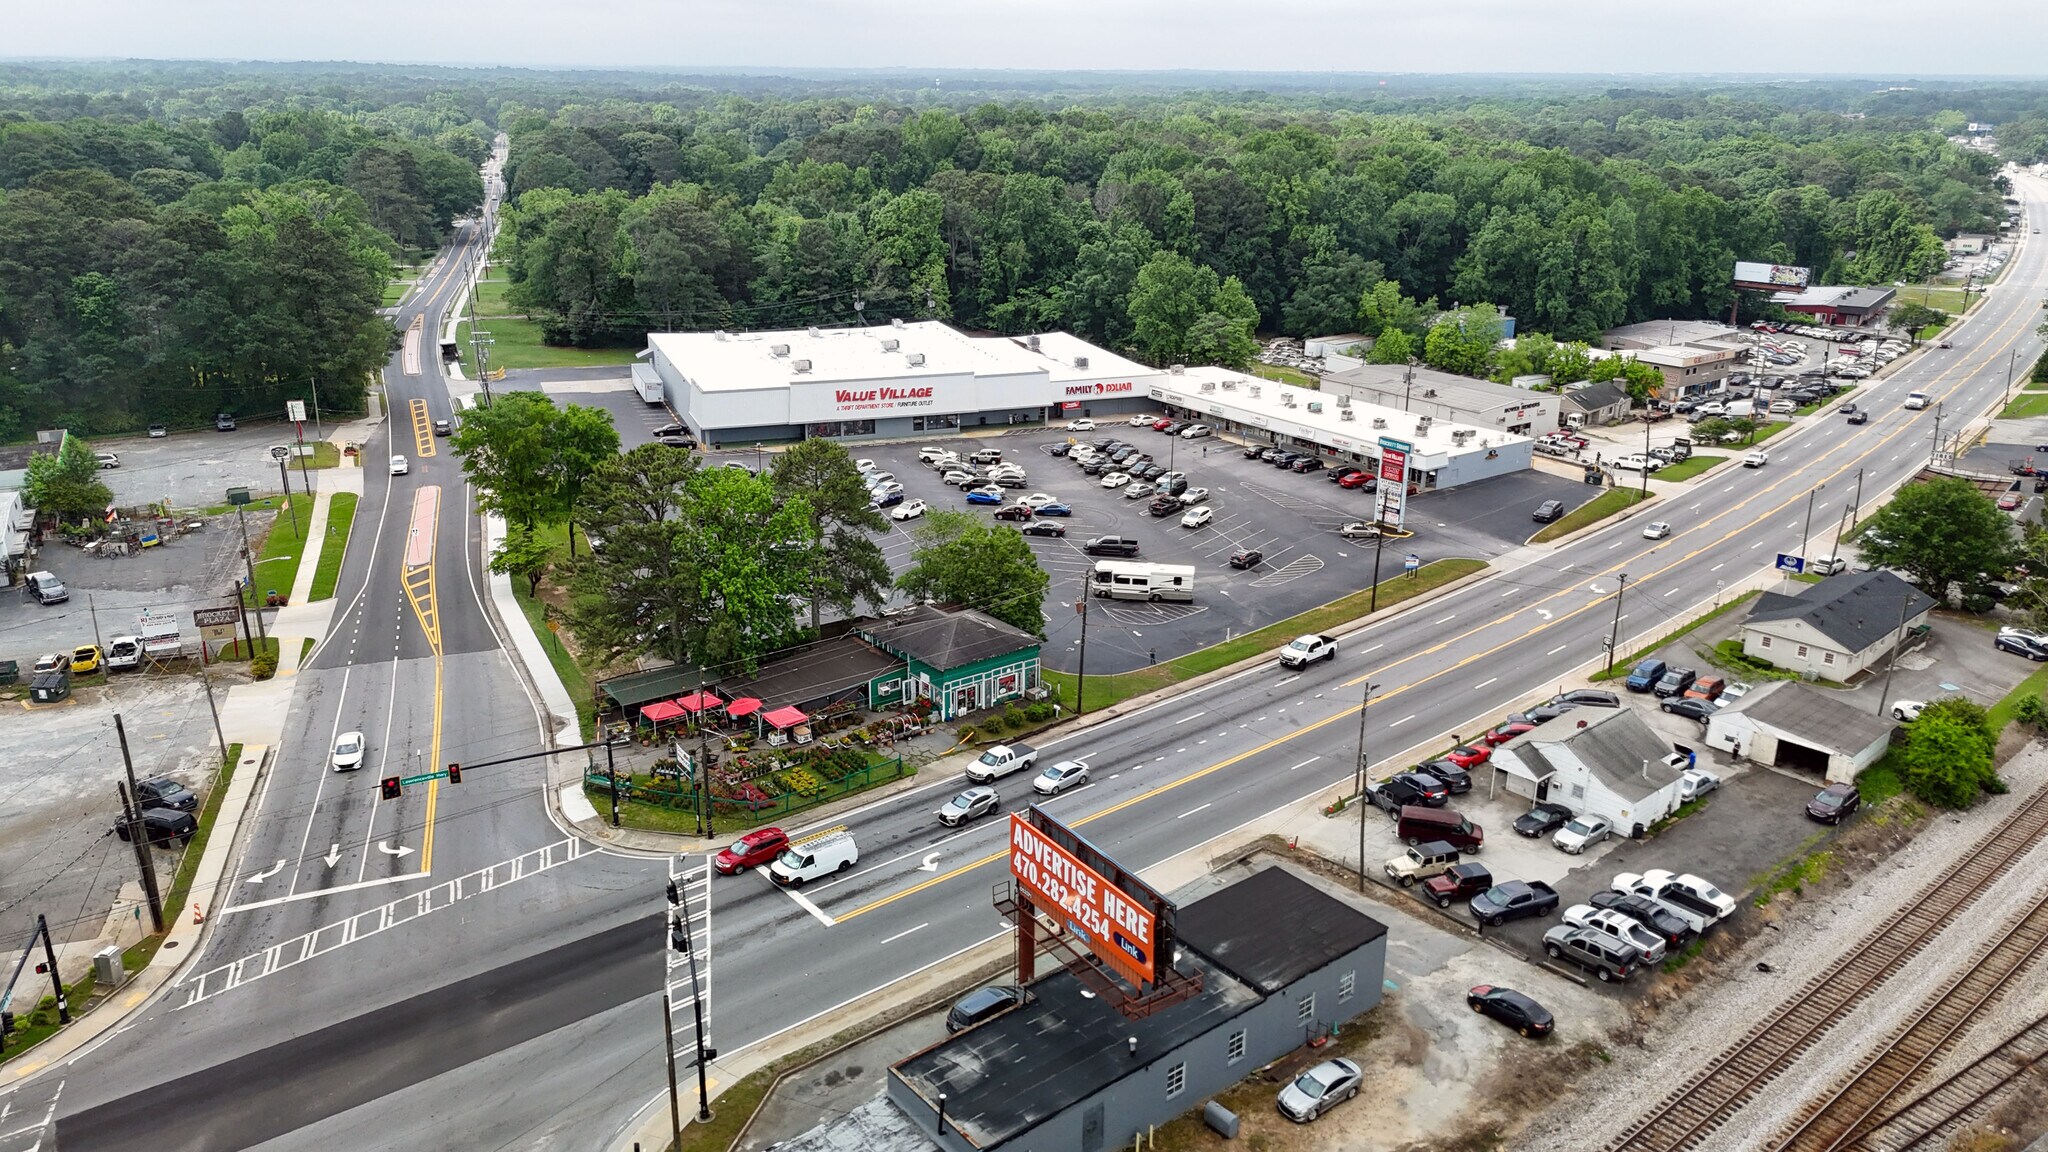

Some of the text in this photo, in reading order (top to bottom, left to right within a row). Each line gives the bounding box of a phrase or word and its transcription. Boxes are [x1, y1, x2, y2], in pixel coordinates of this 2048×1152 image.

[835, 387, 933, 402] VALUE VILLAGE
[1065, 385, 1093, 395] FAMILY
[402, 775, 435, 784] Lawrenceville
[1013, 823, 1149, 944] ADVERTISE HERE
[1013, 851, 1110, 942] 470.282.4254
[1069, 920, 1087, 943] Link
[1121, 937, 1139, 959] Link
